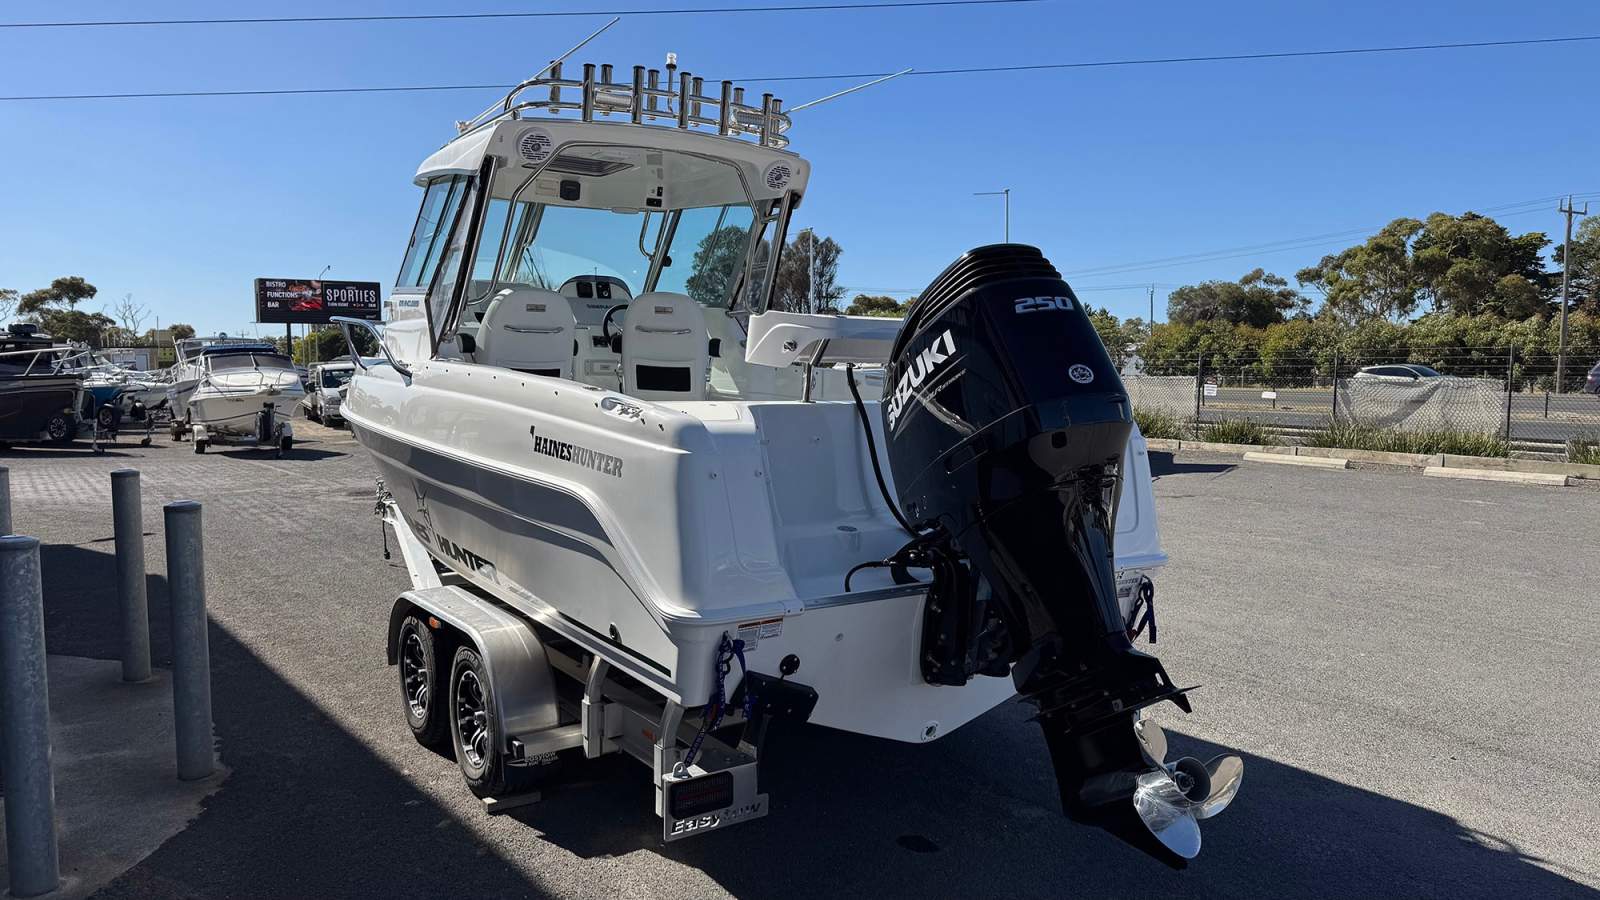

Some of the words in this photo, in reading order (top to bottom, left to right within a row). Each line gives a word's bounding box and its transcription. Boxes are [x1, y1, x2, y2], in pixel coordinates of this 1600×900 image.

[326, 288, 376, 303] SPORTIES
[1014, 296, 1075, 314] 250
[887, 329, 956, 432] SUZUKI
